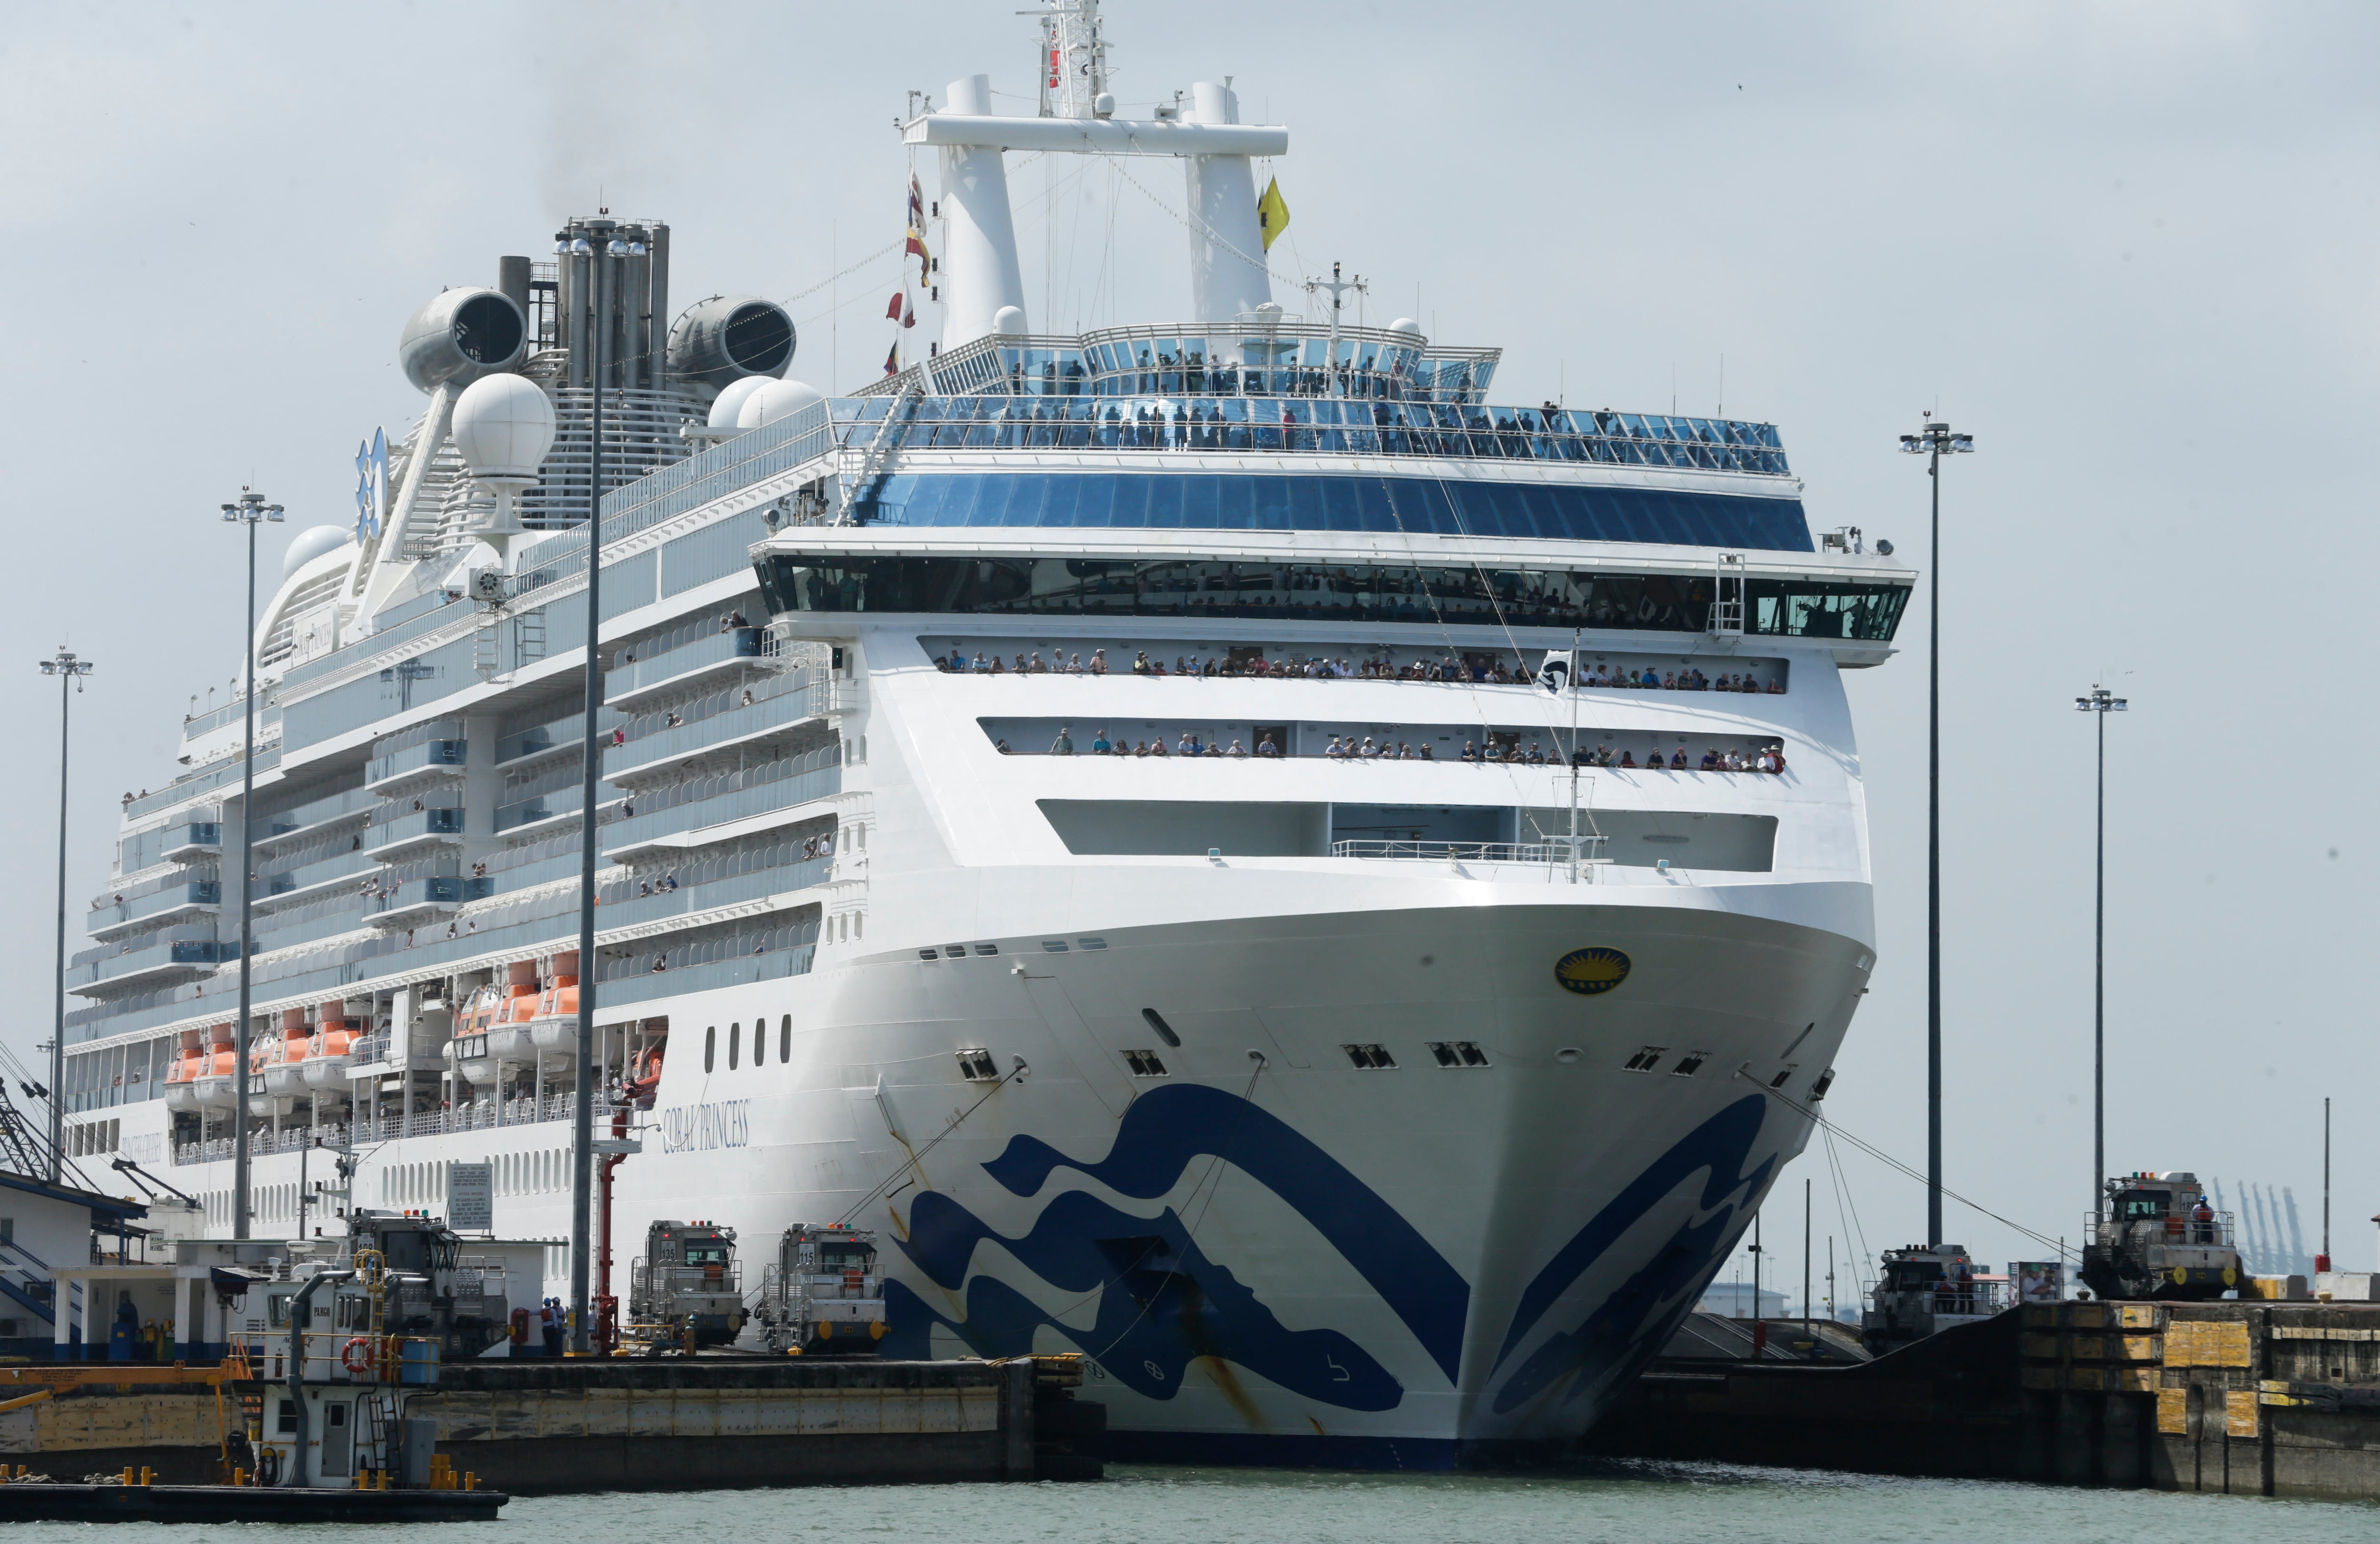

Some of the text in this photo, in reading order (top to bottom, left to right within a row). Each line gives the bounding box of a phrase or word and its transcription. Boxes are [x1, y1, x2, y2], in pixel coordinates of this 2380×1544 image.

[663, 1098, 749, 1154] CORAL PRINCESS
[662, 1249, 674, 1259] 135
[800, 1252, 813, 1263] 115
[314, 1307, 330, 1317] PARGO
